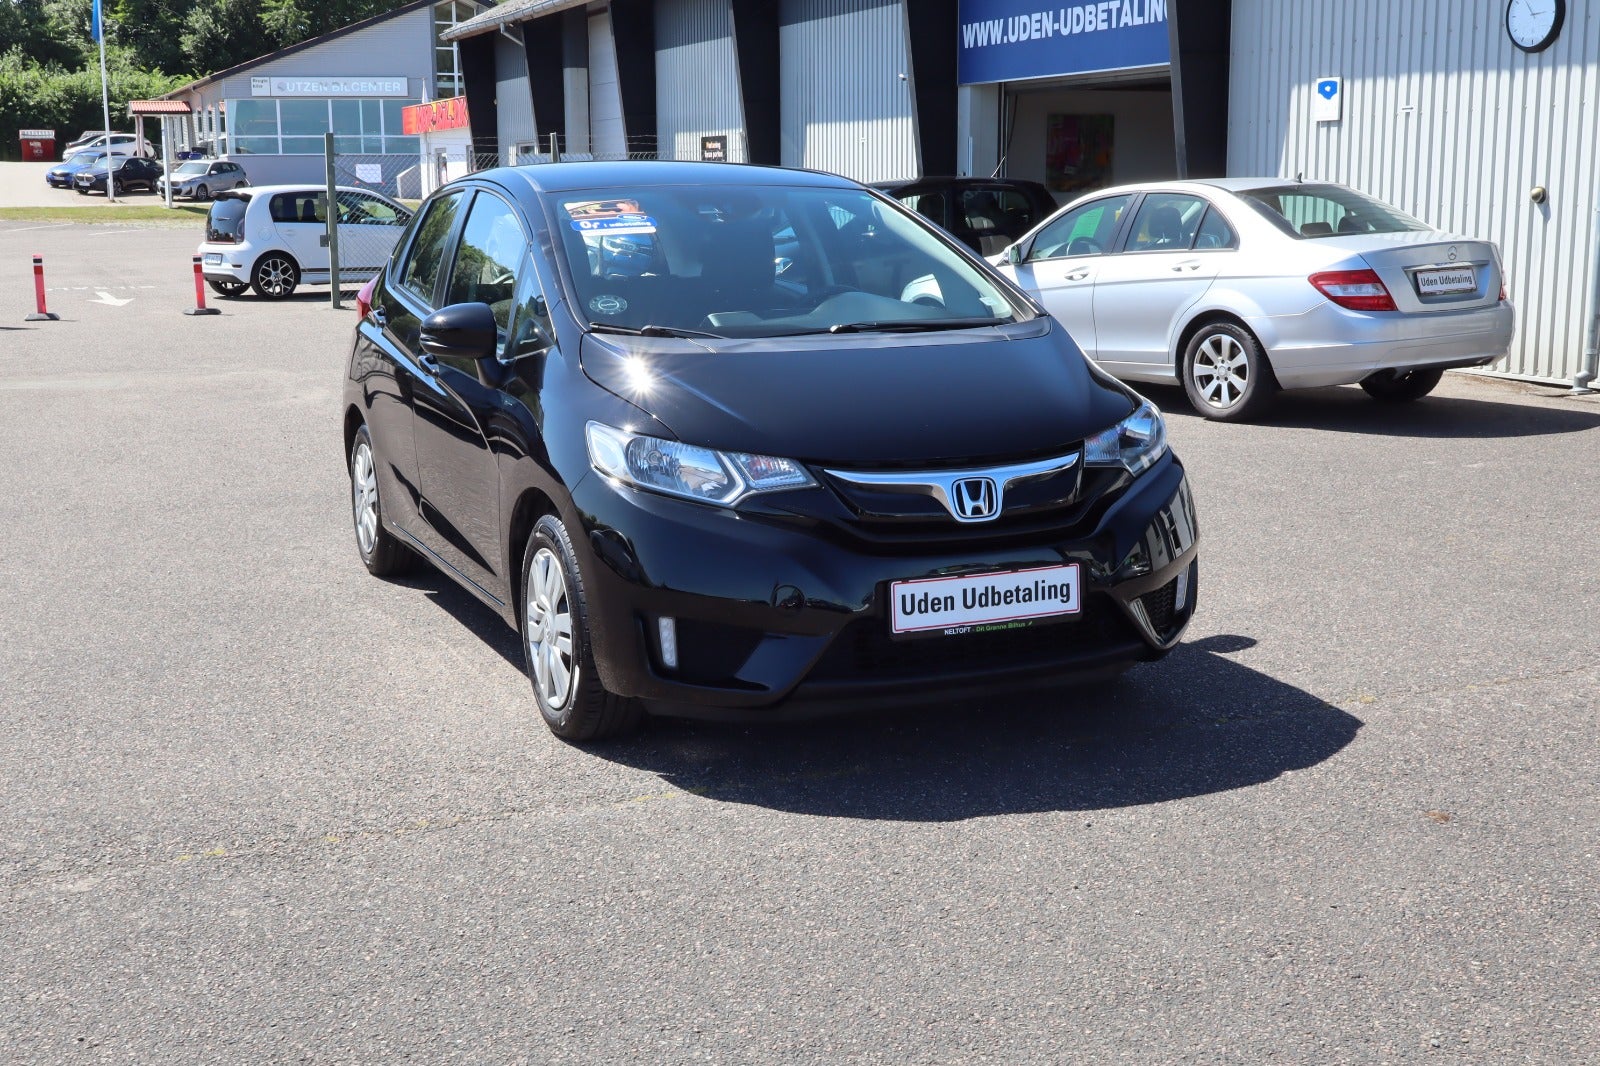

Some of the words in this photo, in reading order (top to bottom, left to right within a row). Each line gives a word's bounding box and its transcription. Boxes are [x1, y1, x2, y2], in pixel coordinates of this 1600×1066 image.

[962, 0, 1168, 49] WWW.UDEN-UDBETALIN
[1420, 277, 1438, 287] Uden
[1439, 274, 1473, 285] Udbetaling
[901, 592, 955, 616] Uden
[962, 580, 1071, 610] Udbetaling
[944, 626, 971, 636] NELTOFT
